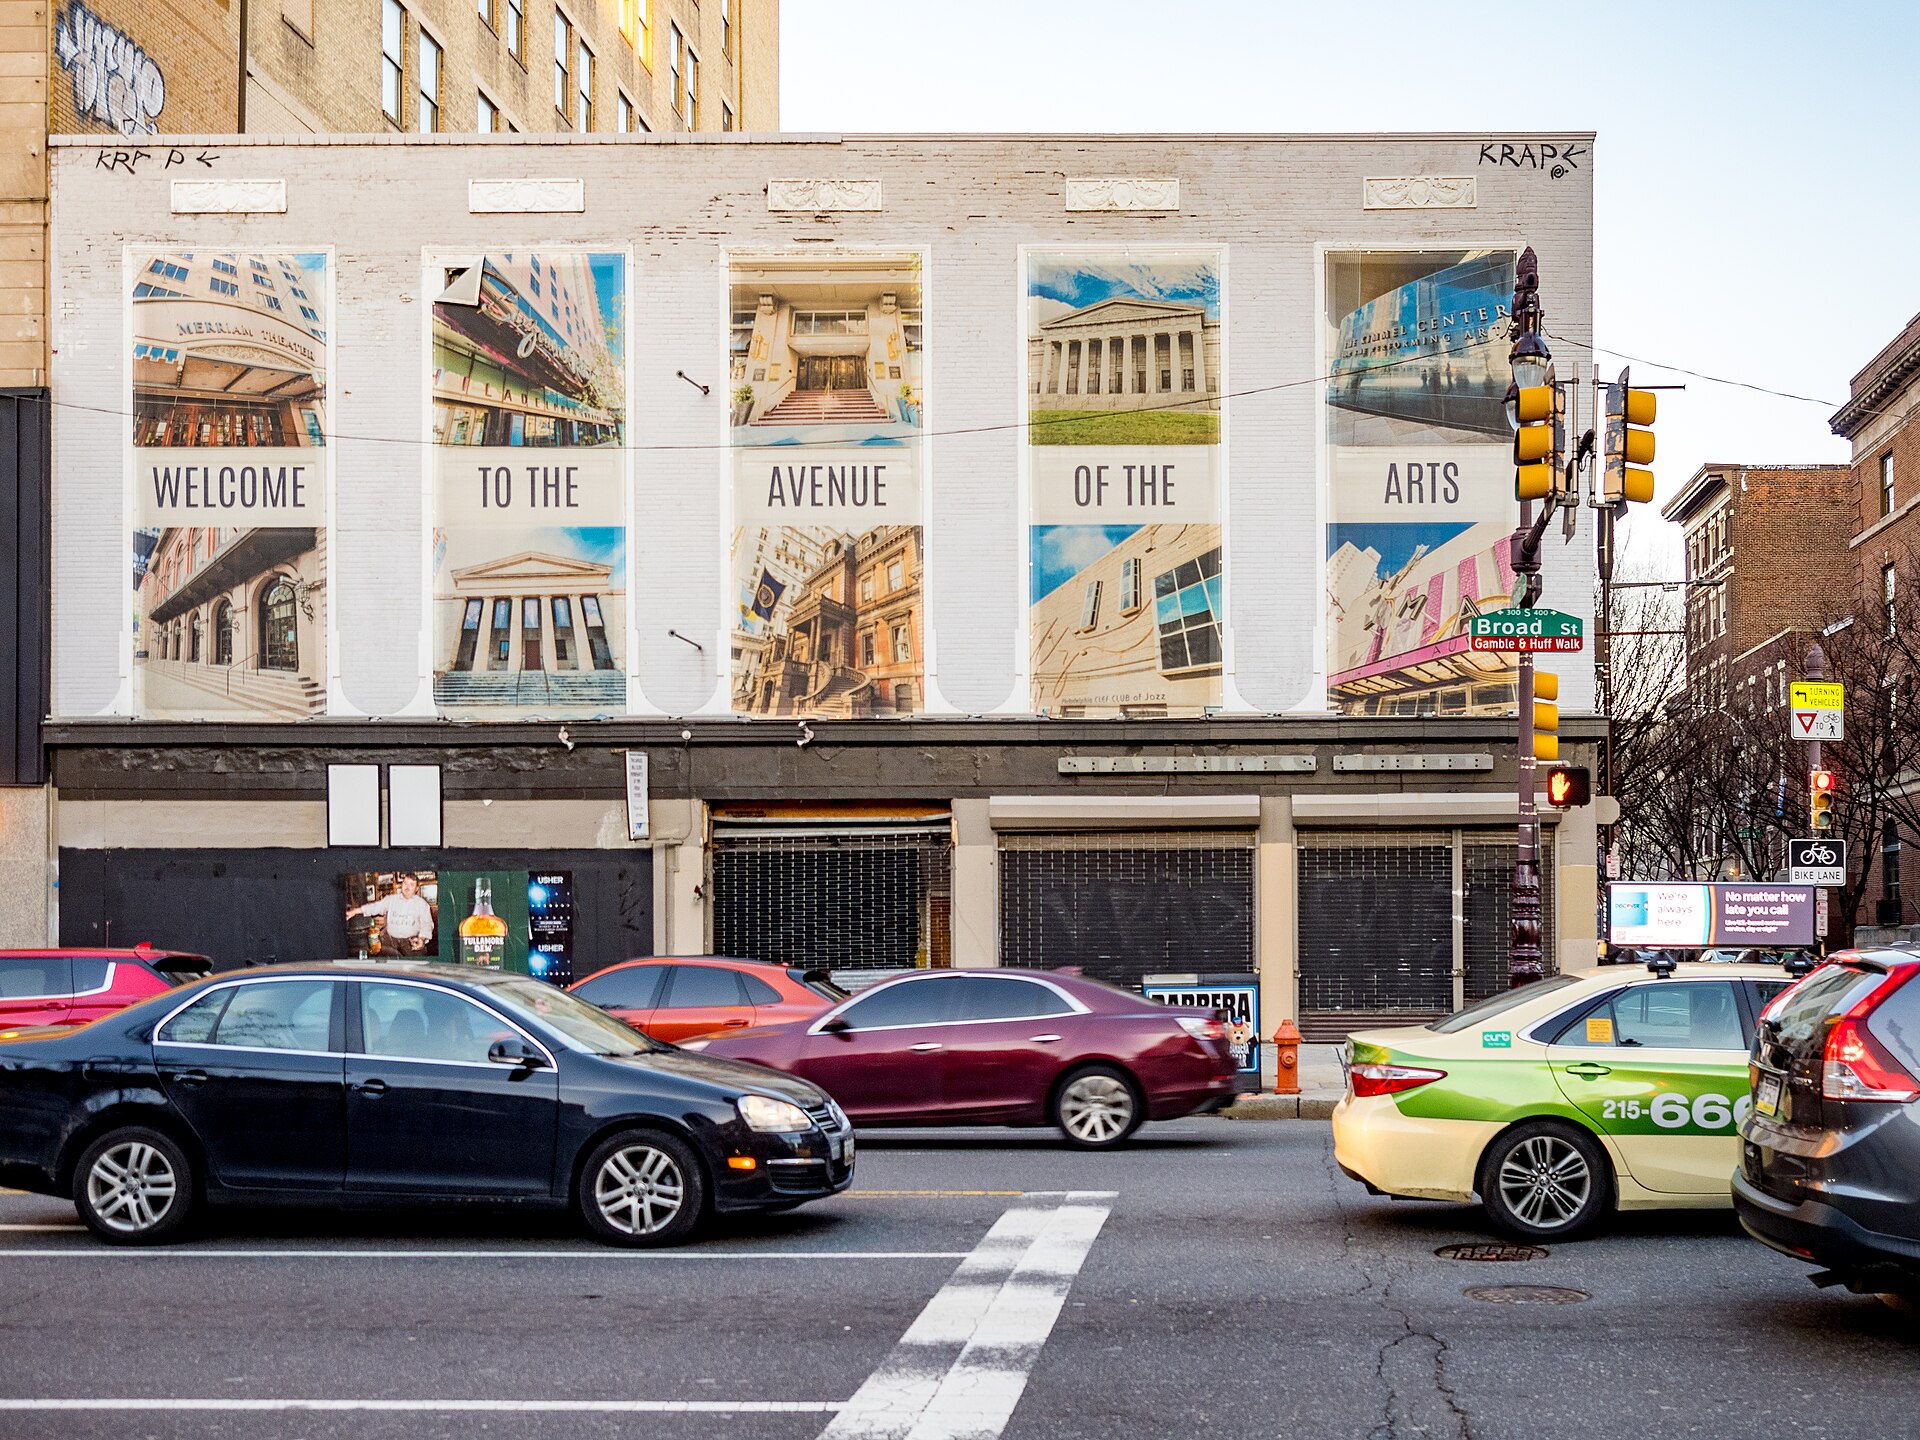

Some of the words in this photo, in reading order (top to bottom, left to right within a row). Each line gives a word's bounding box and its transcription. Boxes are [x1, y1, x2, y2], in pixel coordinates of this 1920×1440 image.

[1479, 144, 1558, 169] KRAP
[1361, 325, 1408, 346] KIMMEL
[1417, 304, 1512, 333] CENTER
[1464, 325, 1501, 340] ART
[177, 321, 253, 337] MERRIAM
[261, 330, 315, 361] THEATER
[153, 466, 305, 508] WELCOME
[478, 466, 511, 508] TO
[526, 466, 579, 508] THE
[768, 465, 887, 507] AVENUE
[1075, 465, 1109, 507] OF
[1123, 465, 1175, 506] THE
[1384, 462, 1459, 504] ARTS
[1524, 608, 1531, 617] S
[1477, 618, 1542, 635] Broad
[1560, 623, 1578, 635] St
[1474, 638, 1515, 649] Gamble
[1518, 638, 1527, 649] &
[1529, 638, 1552, 649] Huff
[1555, 638, 1581, 649] Walk
[1809, 687, 1840, 697] TURNING
[1111, 694, 1130, 703] CLUB
[1133, 693, 1142, 701] of
[1809, 698, 1840, 707] VEHICLES
[1815, 722, 1824, 730] TO
[537, 875, 564, 885] USHER
[1794, 871, 1814, 880] BIKE
[1817, 871, 1841, 880] LANE
[1657, 891, 1688, 901] We're
[1725, 891, 1742, 902] No
[1743, 891, 1780, 902] matter
[1780, 890, 1806, 902] how
[1657, 904, 1693, 915] always
[1725, 903, 1747, 915] late
[1747, 906, 1768, 917] you
[1769, 904, 1789, 915] call
[1657, 917, 1682, 927] here
[463, 936, 505, 946] TULLAMORE
[538, 943, 565, 953] USHER
[1483, 1032, 1510, 1042] curb
